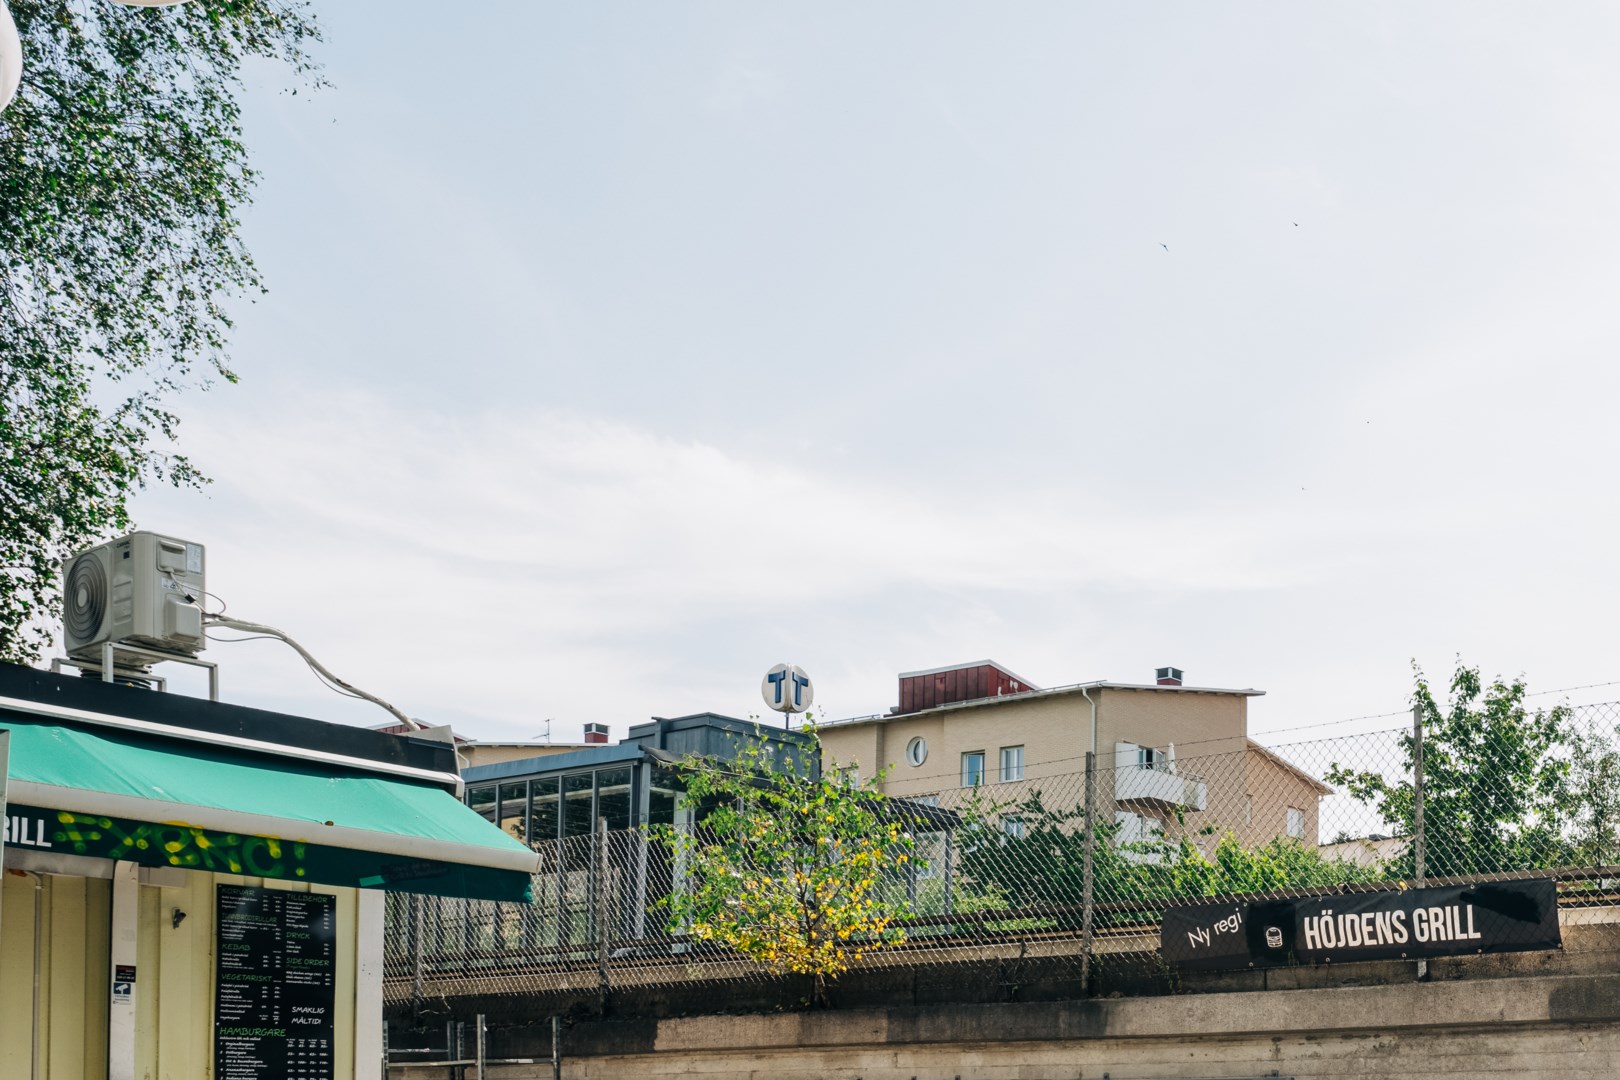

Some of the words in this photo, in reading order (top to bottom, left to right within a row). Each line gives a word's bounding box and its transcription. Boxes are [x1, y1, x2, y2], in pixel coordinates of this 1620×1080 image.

[768, 670, 785, 703] T
[792, 672, 809, 706] T
[286, 893, 328, 904] TILLBEHÖR
[1187, 924, 1212, 949] Ny
[1213, 907, 1243, 936] regi
[1303, 908, 1408, 950] HÖJDENS
[1412, 904, 1482, 943] GRILL
[286, 932, 311, 940] DRYCK
[221, 943, 252, 952] KEBAB
[286, 957, 303, 966] SIDE
[304, 958, 330, 967] ORDER
[221, 973, 273, 983] VEGETARISKT
[291, 1006, 325, 1014] SMAKLIG
[219, 1027, 287, 1037] HAMBURGARE
